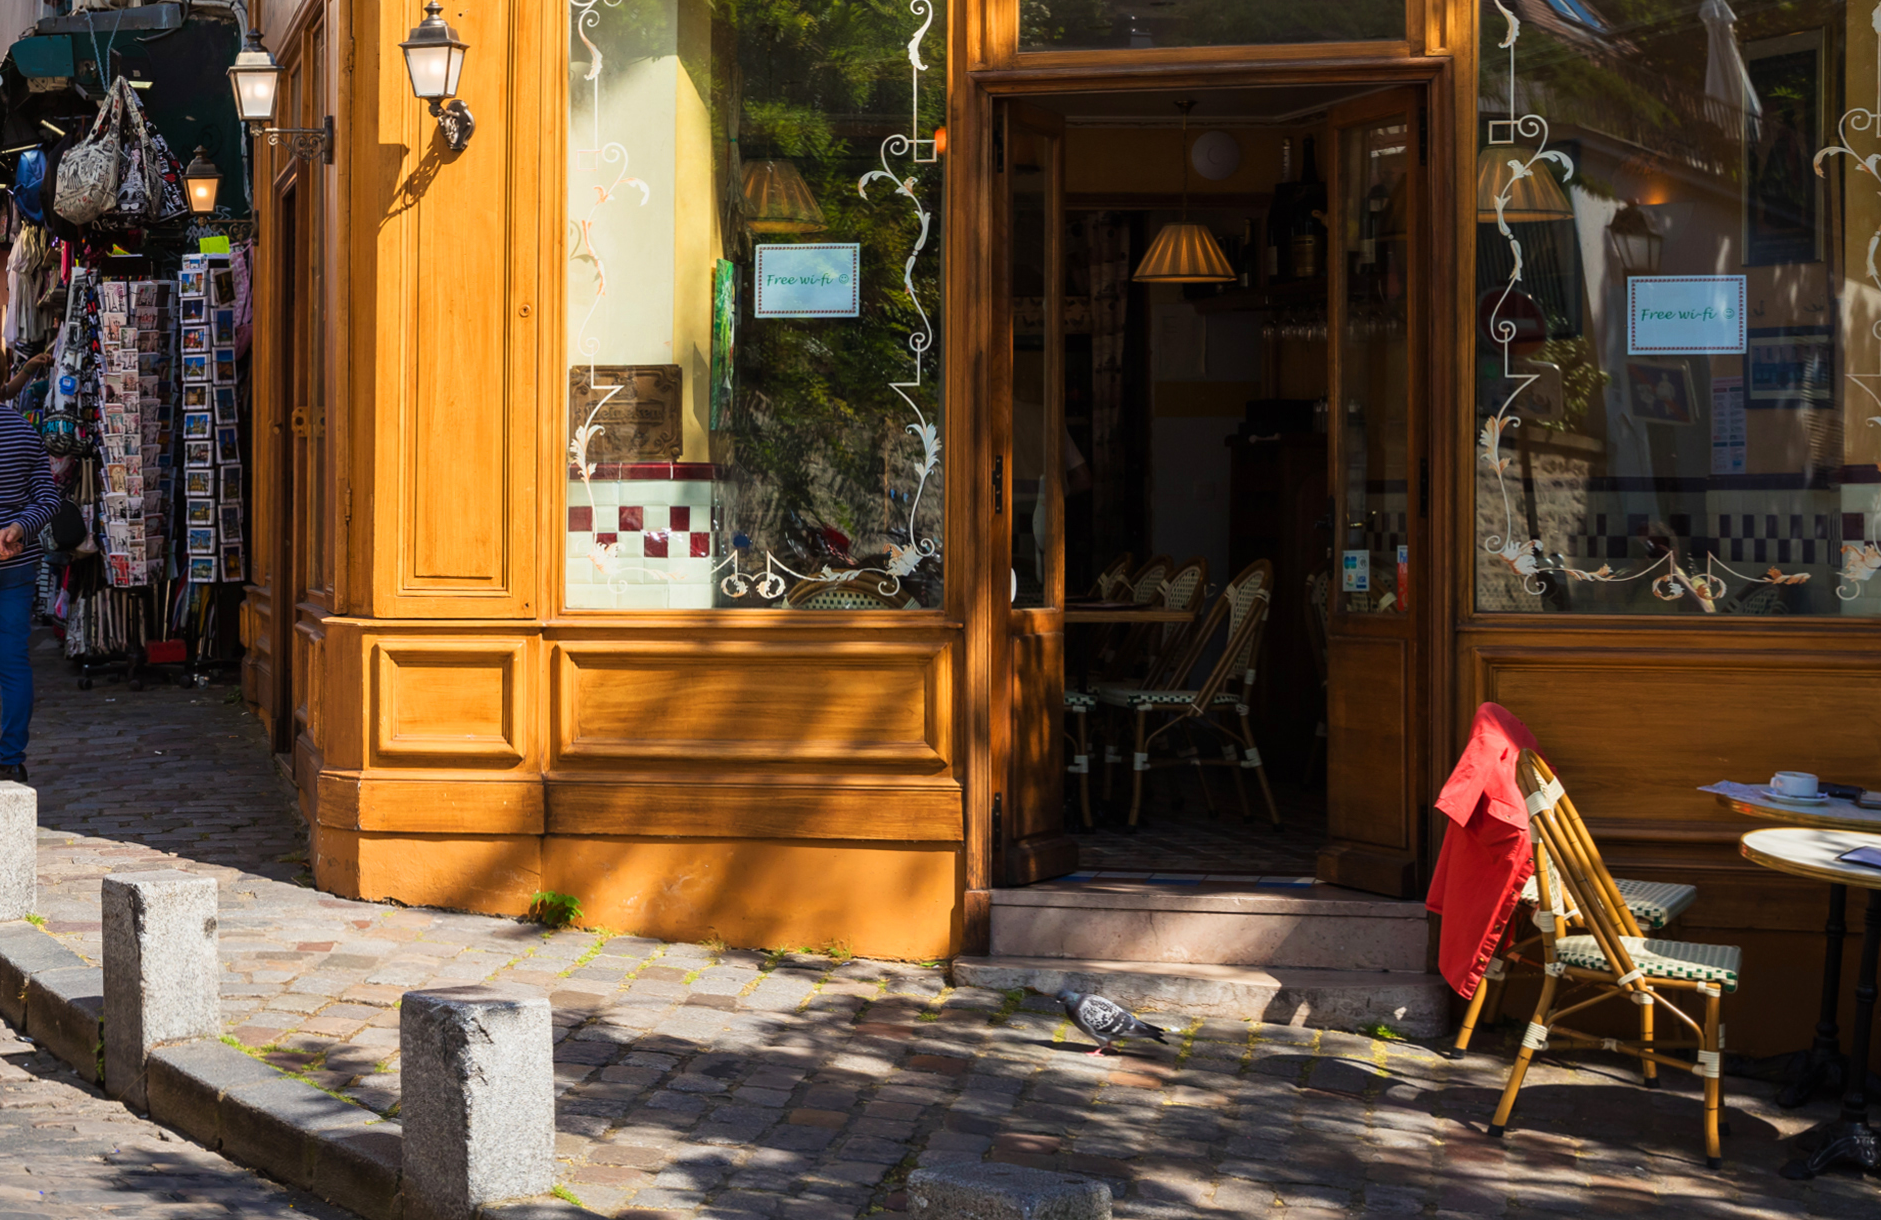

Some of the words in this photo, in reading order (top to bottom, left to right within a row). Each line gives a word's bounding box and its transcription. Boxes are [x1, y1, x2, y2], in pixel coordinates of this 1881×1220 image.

[767, 274, 798, 286] Free
[799, 272, 833, 286] wi-fi
[1641, 308, 1676, 321] Free
[1678, 306, 1717, 321] wi-fi
